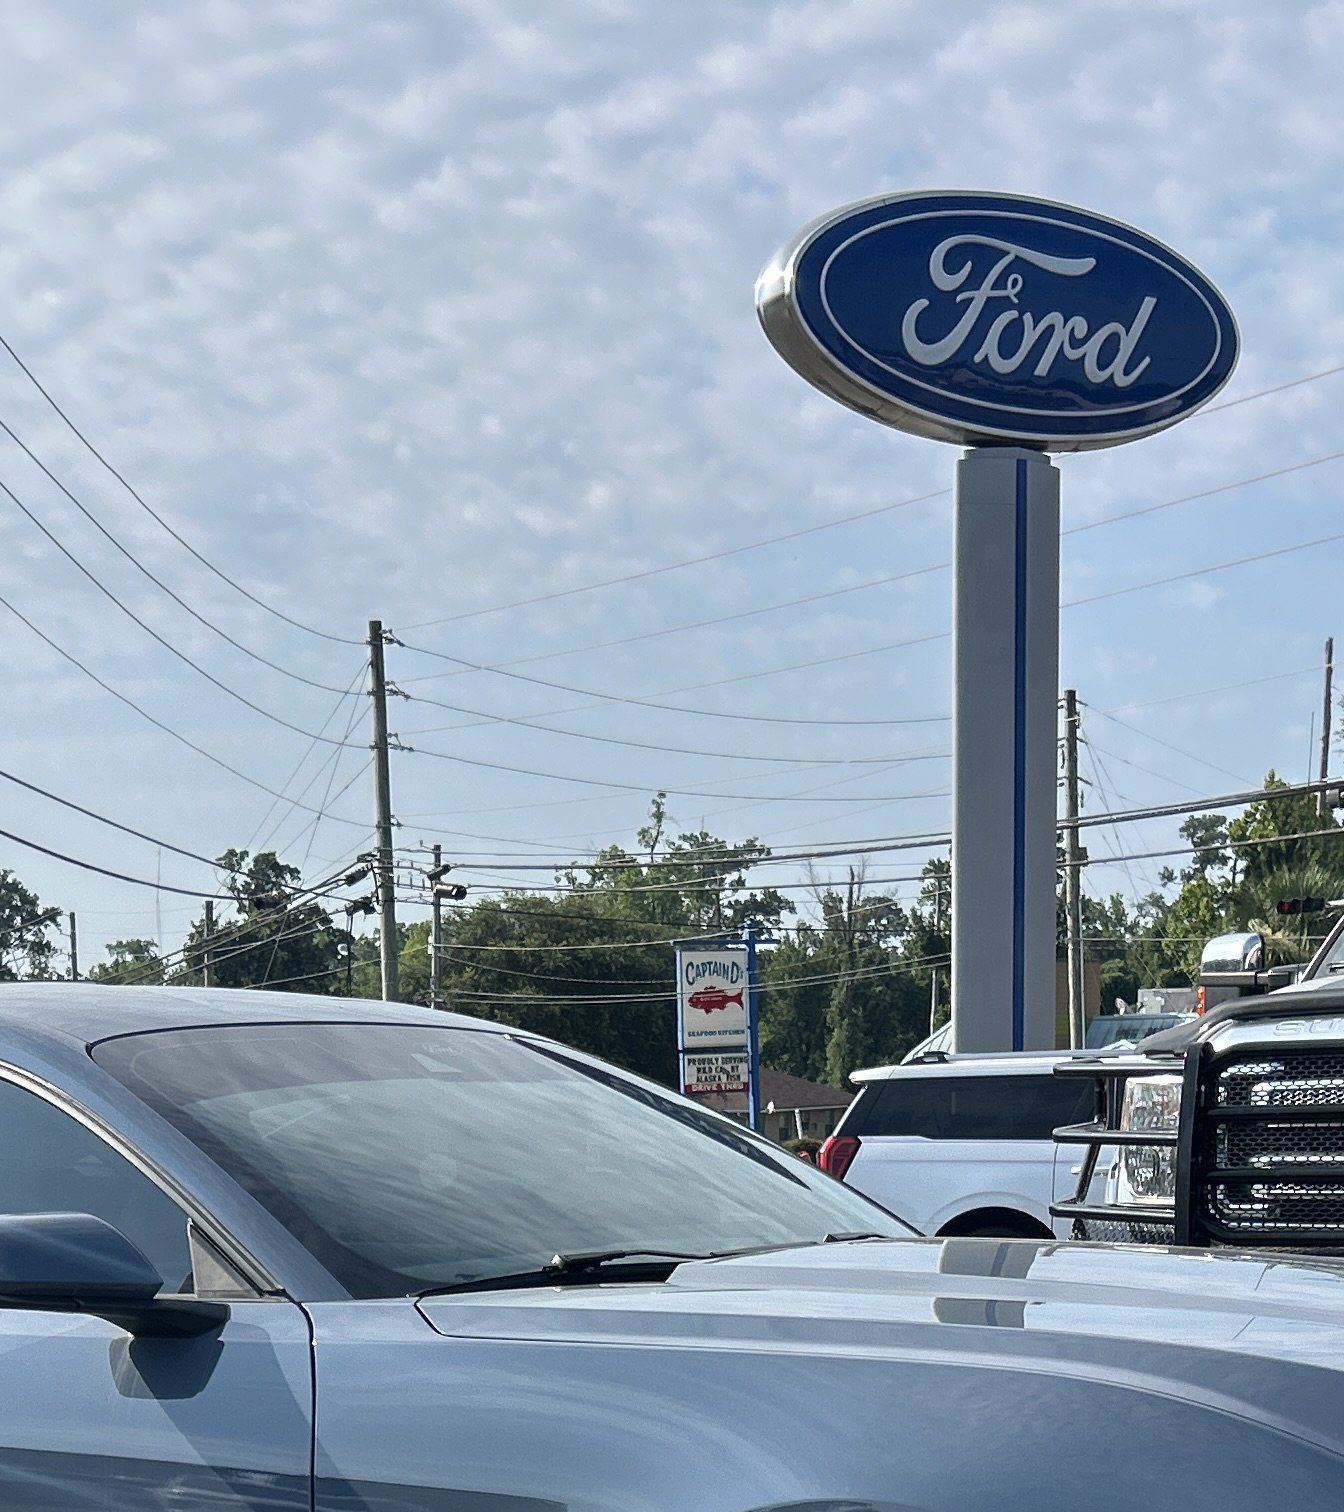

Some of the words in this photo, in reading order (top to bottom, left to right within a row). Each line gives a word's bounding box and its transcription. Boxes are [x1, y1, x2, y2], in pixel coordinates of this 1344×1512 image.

[902, 233, 1157, 388] Ford
[685, 961, 729, 986] CAPTAIN
[688, 1030, 716, 1038] SEAFOOD
[688, 1057, 719, 1066] PROUDLY
[692, 1083, 717, 1092] DRIVE
